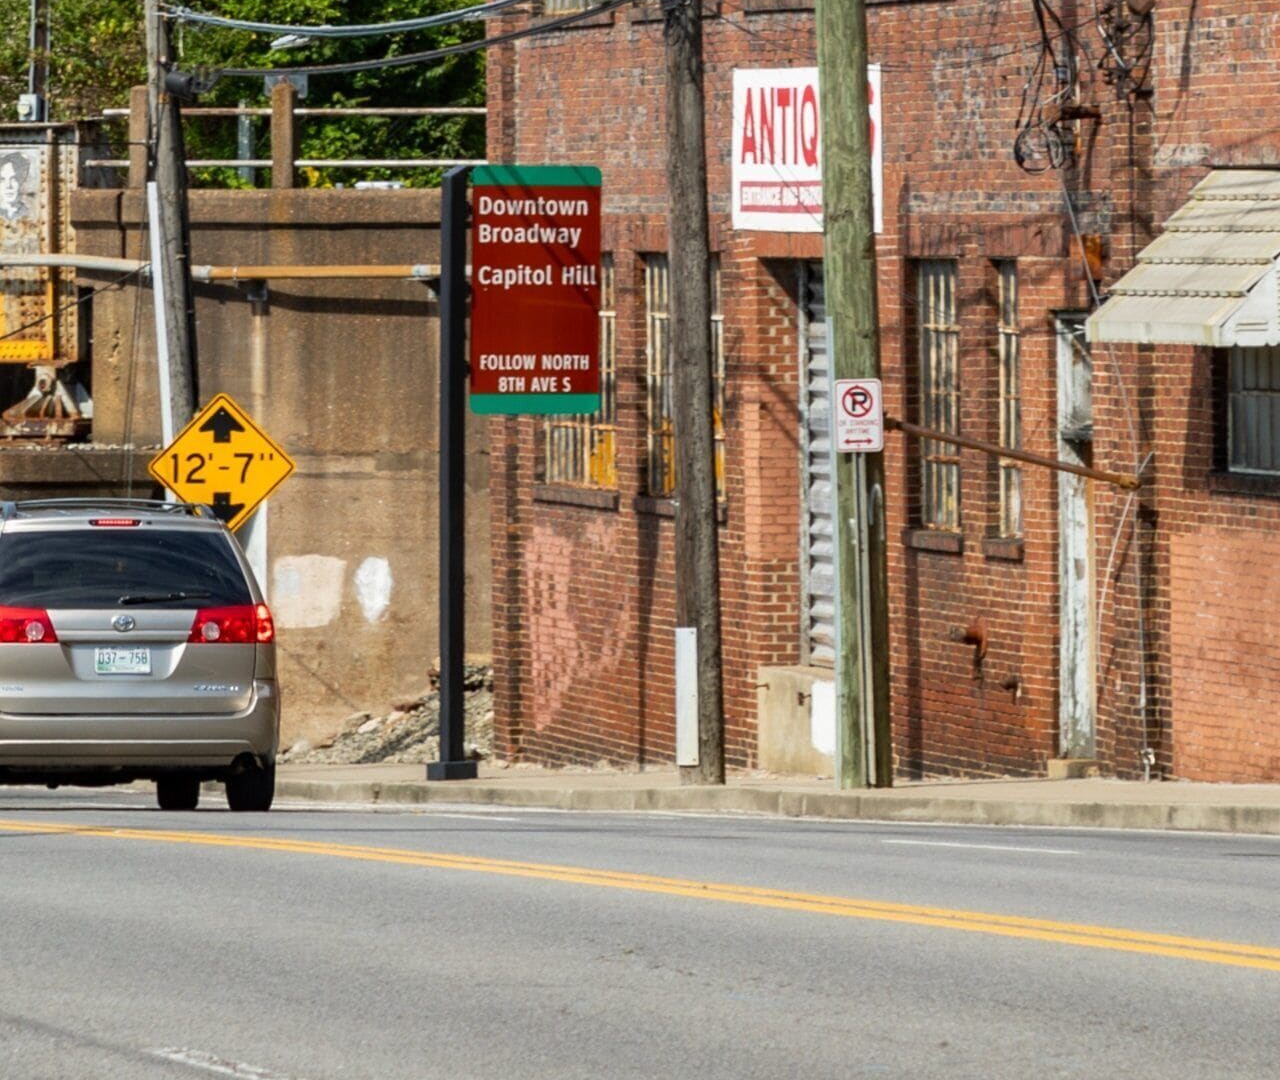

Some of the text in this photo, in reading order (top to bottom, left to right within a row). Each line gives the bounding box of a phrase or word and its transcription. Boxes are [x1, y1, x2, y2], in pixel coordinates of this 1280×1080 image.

[479, 196, 589, 216] Downtown
[478, 224, 582, 248] Broadway
[478, 265, 597, 289] Capitol Hill
[480, 354, 589, 370] FOLLOW NORTH
[498, 376, 571, 393] 8TH AVE S
